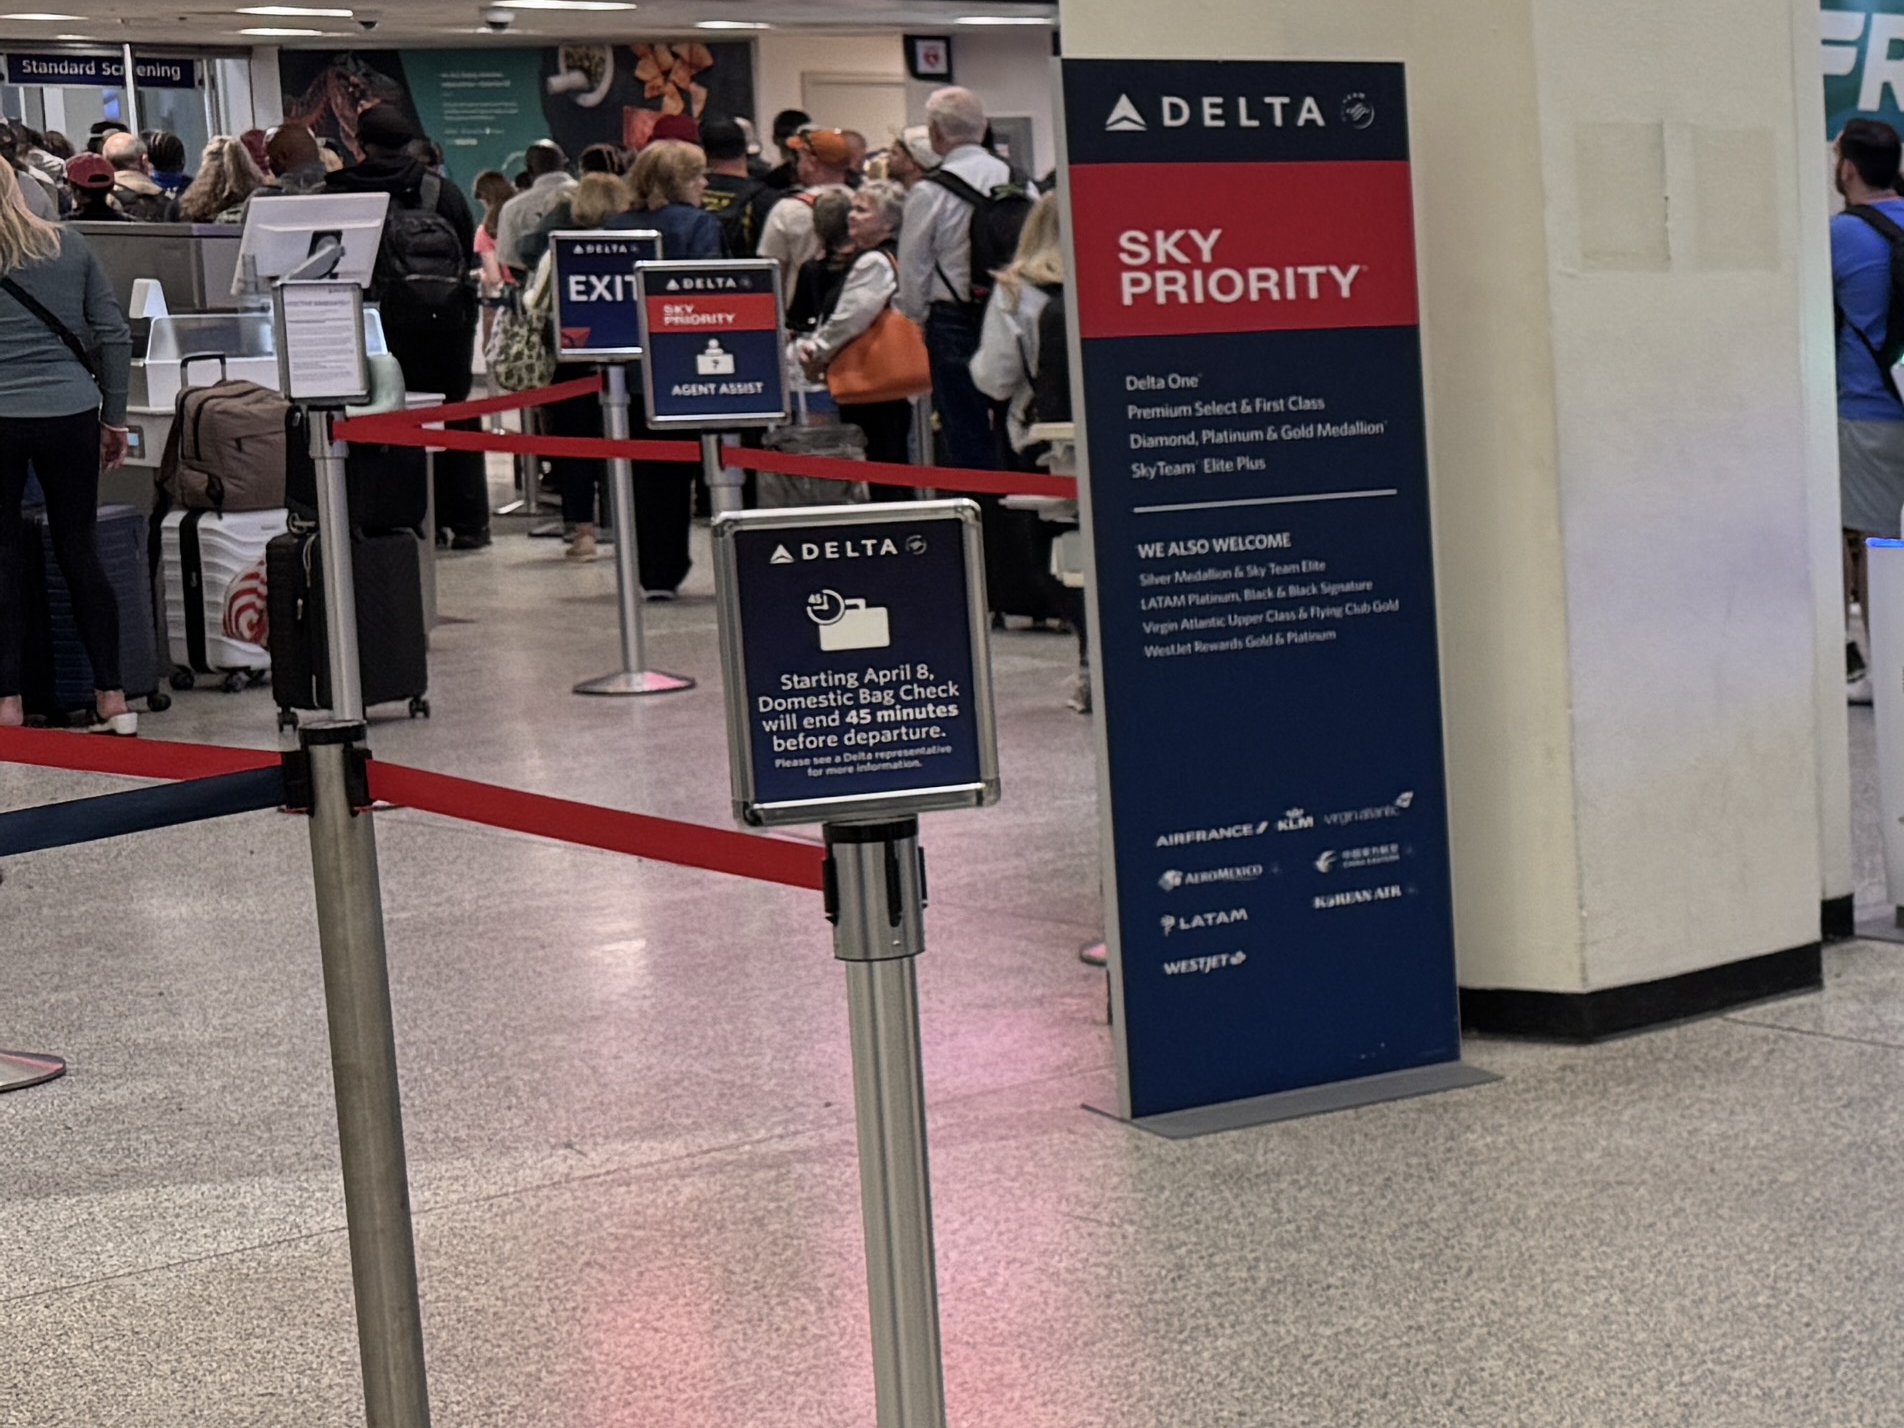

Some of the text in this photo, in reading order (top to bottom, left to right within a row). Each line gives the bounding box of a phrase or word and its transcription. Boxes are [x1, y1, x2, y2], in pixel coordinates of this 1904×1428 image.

[21, 59, 181, 80] Standard Screning
[1161, 96, 1325, 127] DELTA
[585, 244, 628, 254] DELTA
[1119, 229, 1222, 265] SKY
[569, 275, 638, 302] EXIT
[682, 277, 737, 289] DELTA
[1121, 265, 1360, 306] PRIORITY
[663, 304, 695, 317] SKY
[664, 313, 736, 326] PRIORITY
[671, 382, 764, 396] AGENT ASSIST
[1126, 373, 1198, 391] Delta One
[1128, 396, 1325, 419] Premium Select & First Class
[1130, 420, 1384, 449] Diamond, Platinum & Gold Medallion
[1204, 457, 1233, 473] Elite
[1237, 455, 1266, 471] Plus
[802, 538, 898, 561] DELTA
[1138, 533, 1291, 558] WE ALSO WELCOME
[1139, 573, 1171, 586] Silver
[1175, 568, 1232, 583] Medallion
[1269, 562, 1300, 574] Team
[1301, 560, 1326, 572] Elite
[1141, 594, 1185, 610] LATAM
[1244, 586, 1274, 601] Black
[1289, 583, 1317, 597] Black
[1320, 581, 1373, 596] Signature
[1142, 621, 1178, 635] Virgin
[1181, 617, 1225, 631] Atlantic
[1228, 613, 1264, 627] Upper
[1266, 610, 1296, 622] Class
[1311, 606, 1343, 620] Flying
[1345, 601, 1371, 615] Club
[1373, 598, 1399, 612] Gold
[1194, 637, 1243, 653] Rewards
[1245, 634, 1273, 648] Gold
[1287, 631, 1336, 644] Platinum
[781, 663, 935, 691] Starting April 8,
[758, 681, 960, 713] Domestic Bag Check
[762, 702, 959, 733] will end 45 minutes
[773, 725, 946, 753] before departure.
[775, 745, 952, 768] Please see Delta representative
[807, 767, 823, 777] for
[826, 766, 854, 775] more
[1156, 816, 1314, 847] AIRFRANCE KLM
[1374, 885, 1402, 900] AIR
[1180, 909, 1248, 931] LATAM
[1163, 954, 1229, 974] WESTJET
